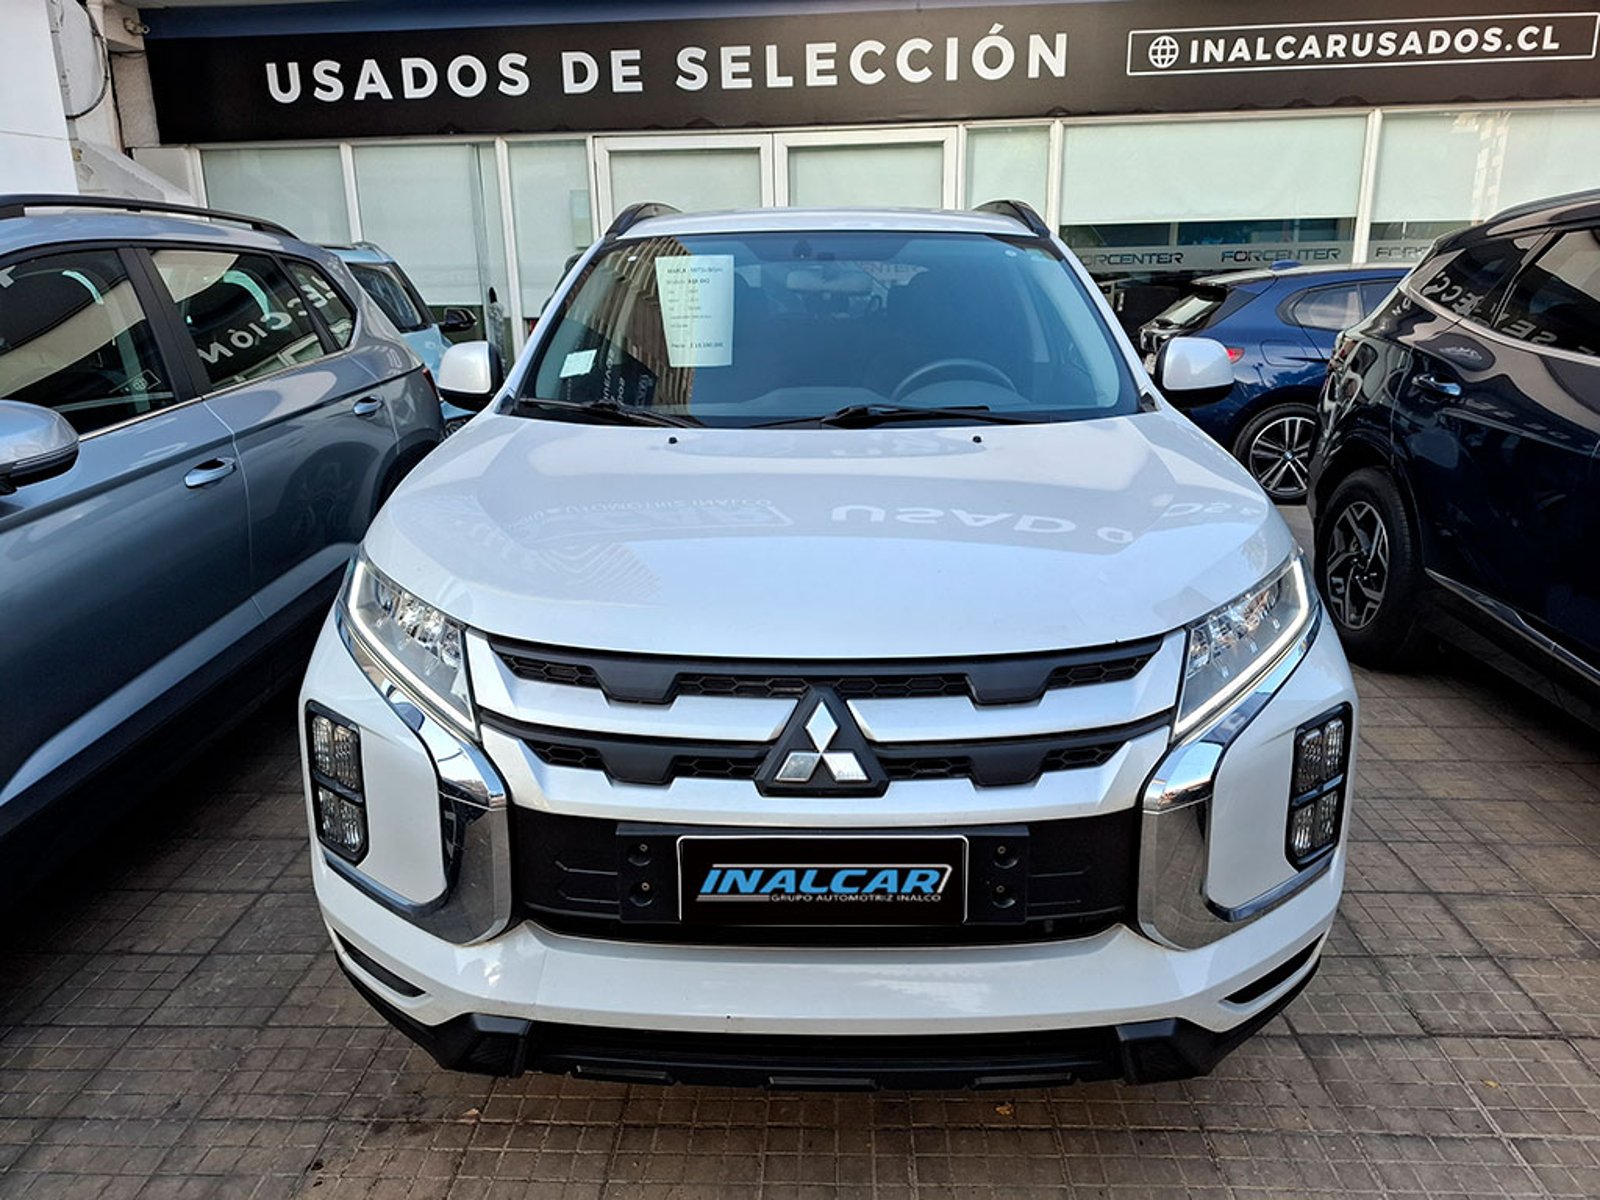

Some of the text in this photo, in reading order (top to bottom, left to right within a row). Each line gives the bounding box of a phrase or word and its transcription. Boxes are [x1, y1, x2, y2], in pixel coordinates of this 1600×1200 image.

[1189, 25, 1560, 64] INALCARUSADOS.CL
[265, 22, 1068, 102] USADOS DE SELECCIÓN
[1080, 252, 1184, 266] ORCENTER
[1221, 247, 1340, 262] FORCENTER
[700, 869, 940, 894] INALCAR
[771, 894, 942, 903] GRUPO AUTOMOTRIZ INALCO
